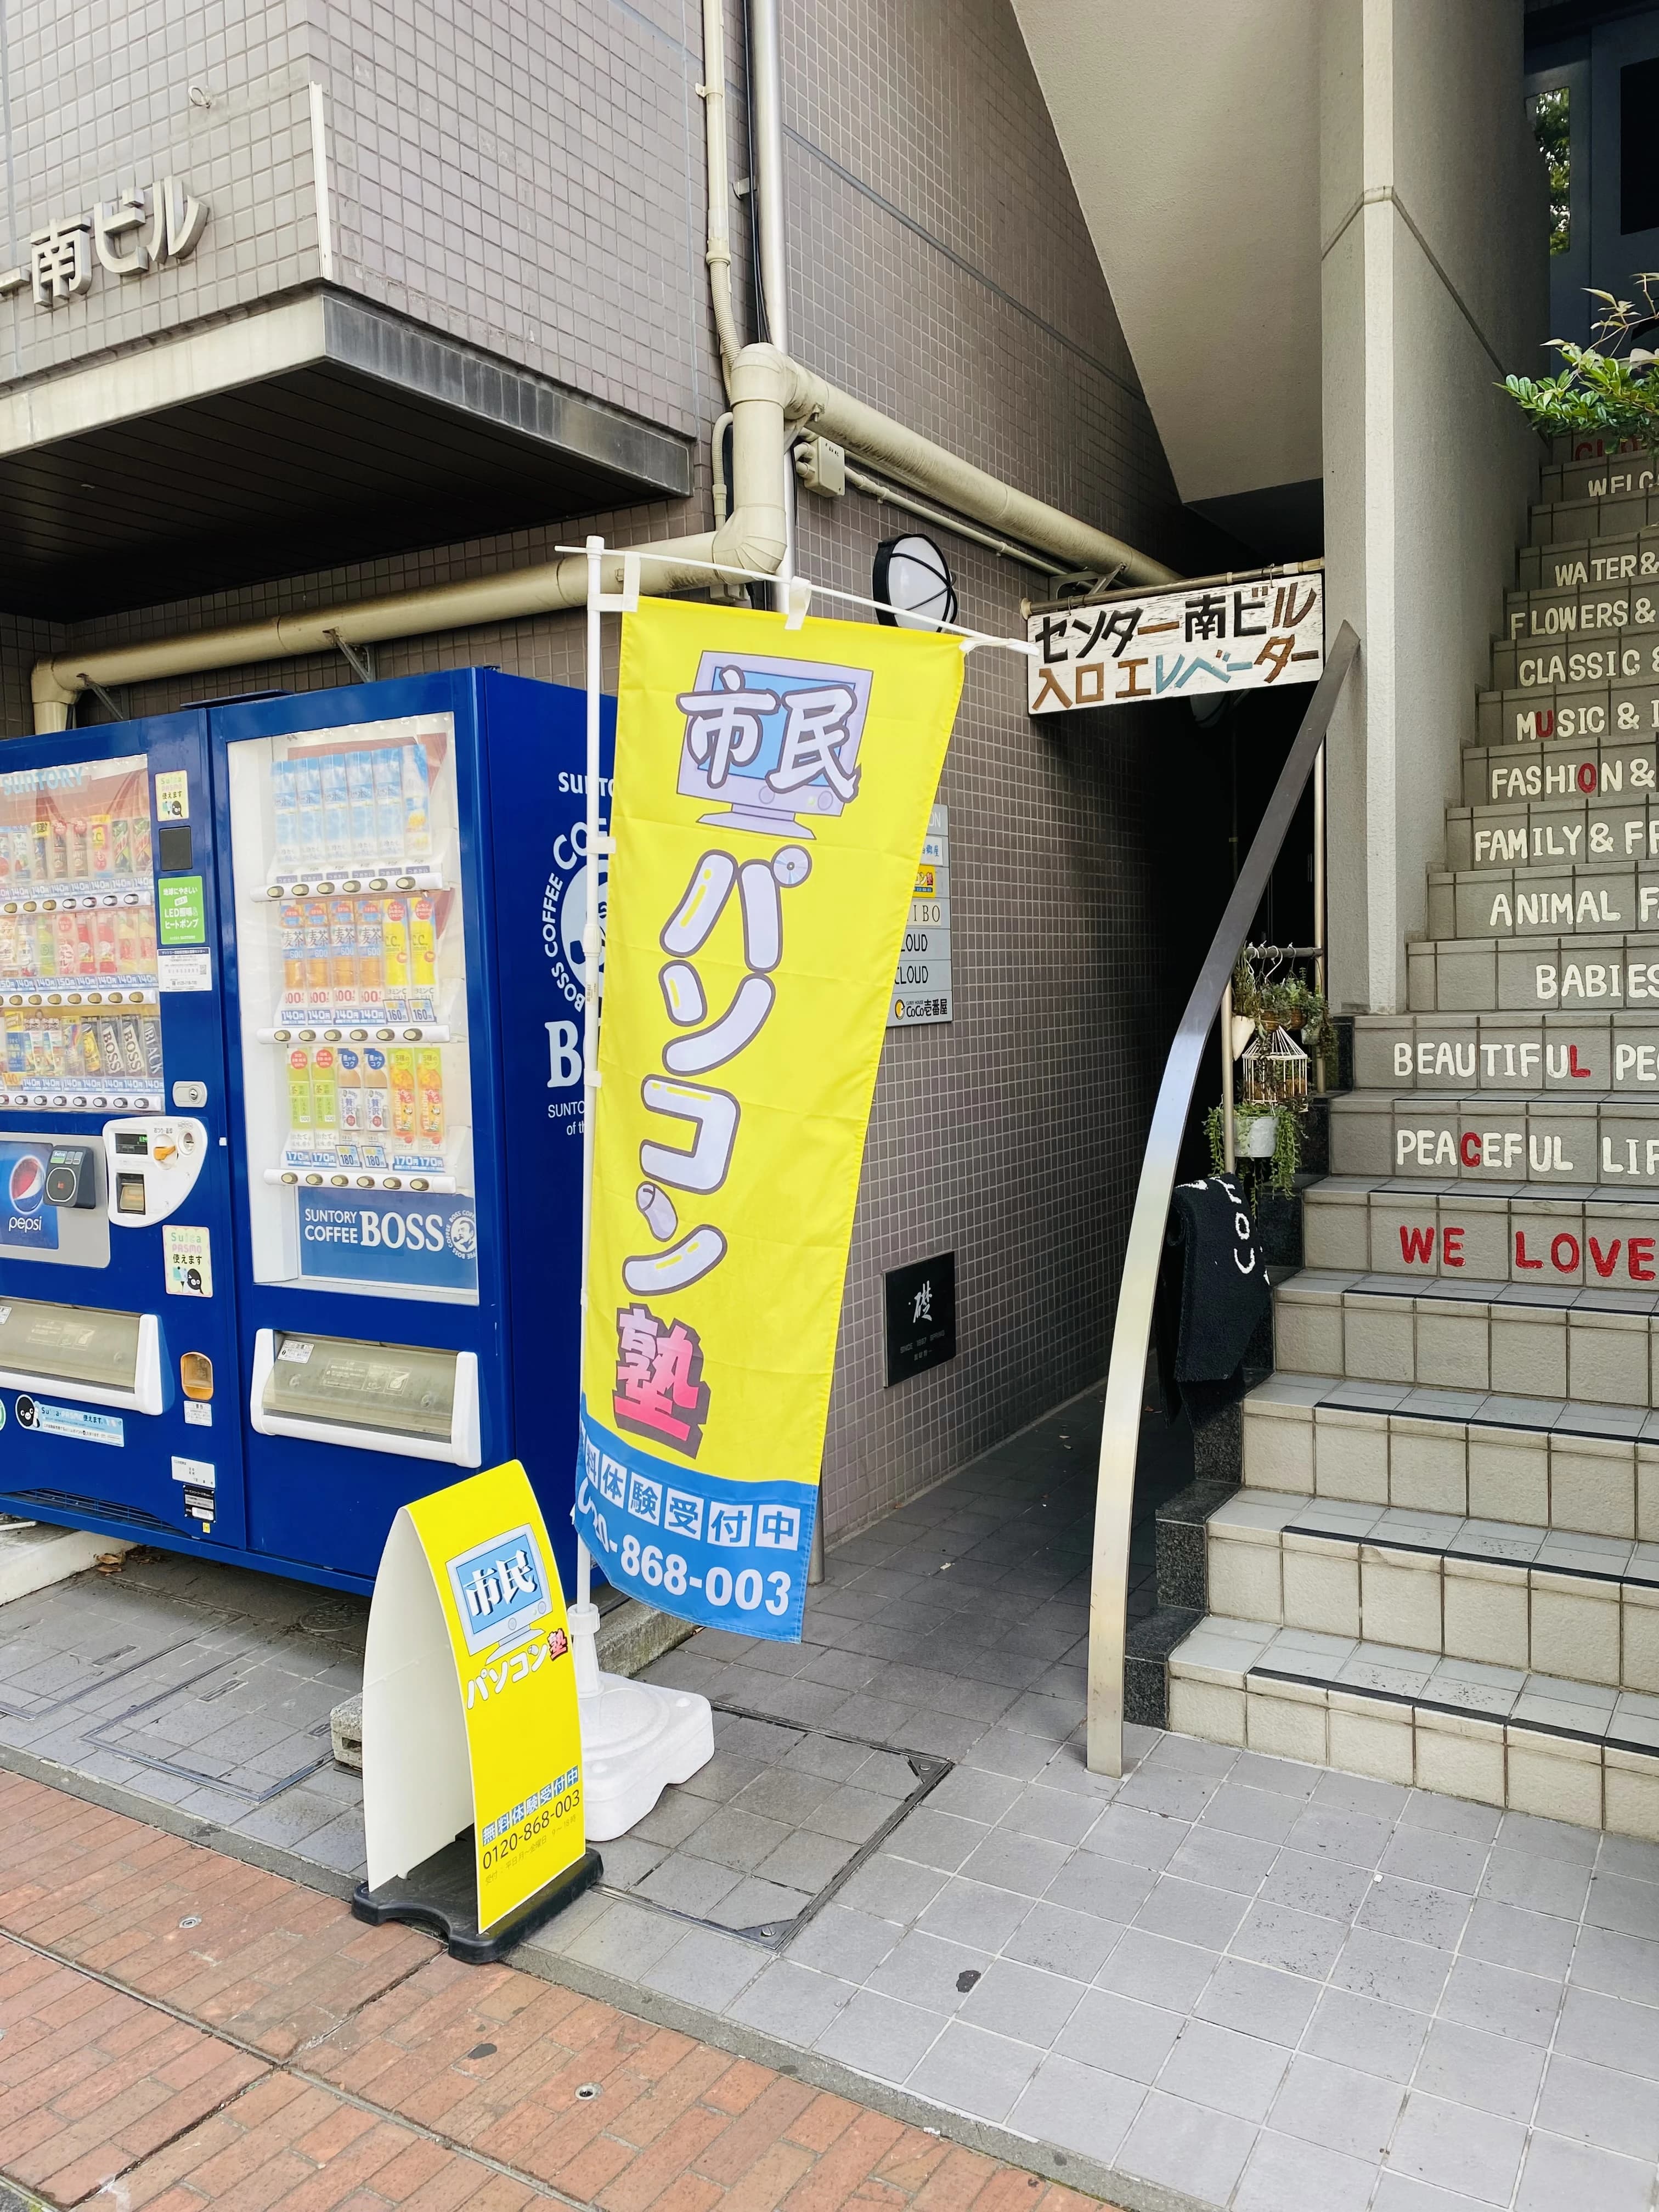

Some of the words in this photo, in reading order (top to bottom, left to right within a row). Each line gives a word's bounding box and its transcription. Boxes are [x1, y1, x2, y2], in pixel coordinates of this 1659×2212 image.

[1555, 554, 1637, 587] WATER
[1035, 582, 1317, 664] センター南ビル
[1511, 600, 1629, 640] FLOWERS
[1635, 597, 1656, 624] &
[1031, 633, 1319, 711] 入口エレベーター
[1519, 649, 1641, 687] CLASSIC
[676, 664, 862, 803] 市民
[1516, 706, 1605, 742] MUSIC
[1617, 702, 1640, 730] &
[1492, 760, 1623, 799] FASHION
[1629, 758, 1655, 787] &
[1475, 825, 1583, 862] FAMILY
[1590, 822, 1613, 853] &
[165, 919, 199, 929] ヒートポンプ
[542, 873, 563, 958] COFFEE
[907, 905, 940, 922] IBO
[1489, 889, 1622, 926] ANIMAL
[1640, 886, 1659, 922] F
[284, 930, 303, 947] 麦茶
[308, 930, 329, 946] 麦茶
[335, 927, 356, 944] 麦茶
[362, 927, 382, 945] 麦茶
[1536, 964, 1659, 999] BABIES
[906, 998, 947, 1017] CoCo壱番屋
[103, 1031, 121, 1071] BOSS
[123, 1030, 142, 1070] BOSS
[1394, 1042, 1590, 1079] BEAUTIFUL
[1615, 1044, 1659, 1081] PE
[548, 1101, 585, 1119] SUNTO
[567, 1121, 577, 1136] of
[612, 845, 812, 1459] パソコン塾
[1396, 1128, 1574, 1172] PEACEFUL
[8, 1216, 42, 1233] pepsi
[304, 1208, 358, 1224] SUNTORY
[359, 1211, 444, 1251] BOSS
[304, 1224, 358, 1244] COFFEE
[172, 1243, 202, 1254] PASMO
[173, 1254, 202, 1265] 使えます
[1400, 1225, 1466, 1267] WE
[1515, 1230, 1657, 1281] LOVE
[582, 1429, 794, 1545] 料体験受付中
[462, 1549, 537, 1616] 市民
[466, 1628, 568, 1710] パソコン塾
[482, 1765, 579, 1847] 無料体験受付中
[483, 1789, 580, 1870] 0120-868-003
